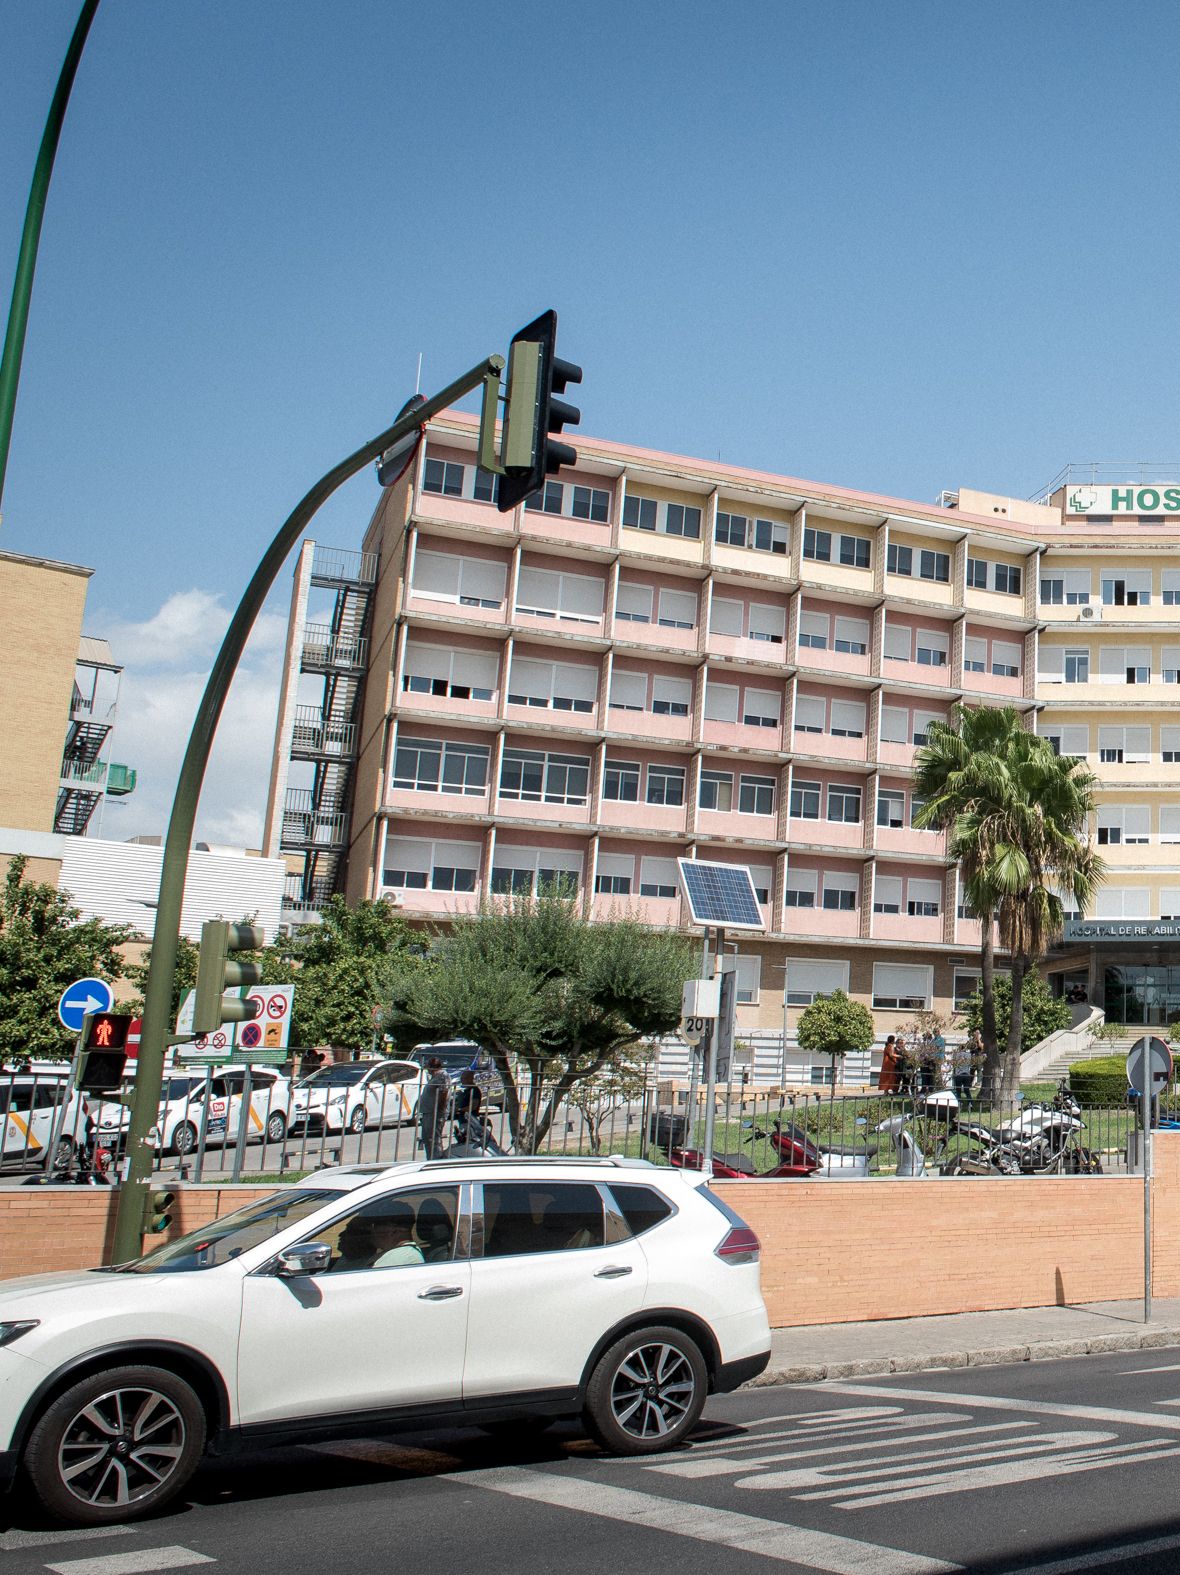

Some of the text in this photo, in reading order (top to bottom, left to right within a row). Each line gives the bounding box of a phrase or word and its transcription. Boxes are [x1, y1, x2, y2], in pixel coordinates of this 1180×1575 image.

[1070, 926, 1116, 937] HOSPITAL
[1118, 926, 1132, 936] DE
[686, 1018, 704, 1032] 20
